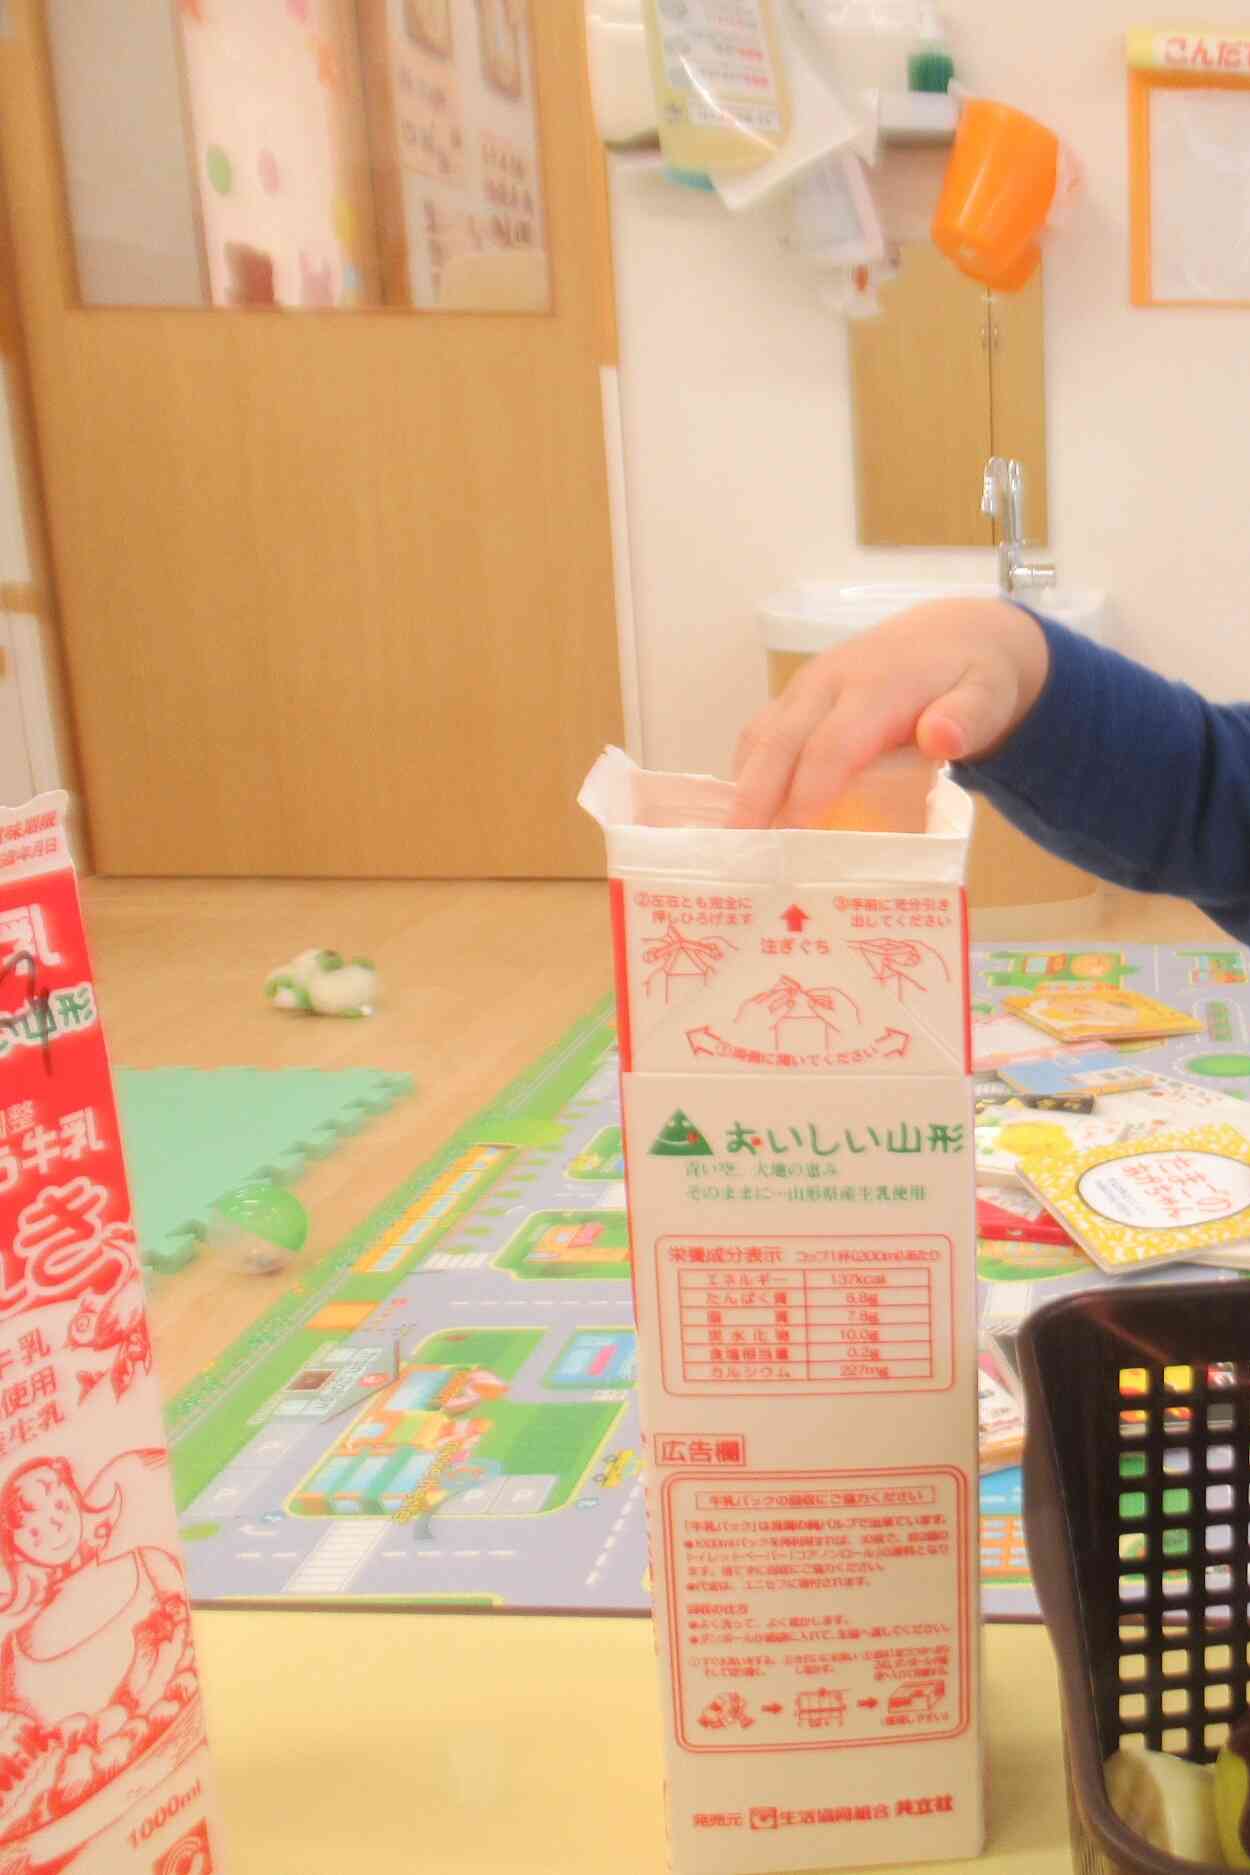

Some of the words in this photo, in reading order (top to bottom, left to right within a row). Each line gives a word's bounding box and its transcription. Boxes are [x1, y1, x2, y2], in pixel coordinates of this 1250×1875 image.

[725, 1121, 963, 1156] おいしい山形
[670, 1246, 784, 1263] 栄養成分表示
[661, 1440, 740, 1463] 広告欄
[127, 1776, 204, 1849] 1000ml
